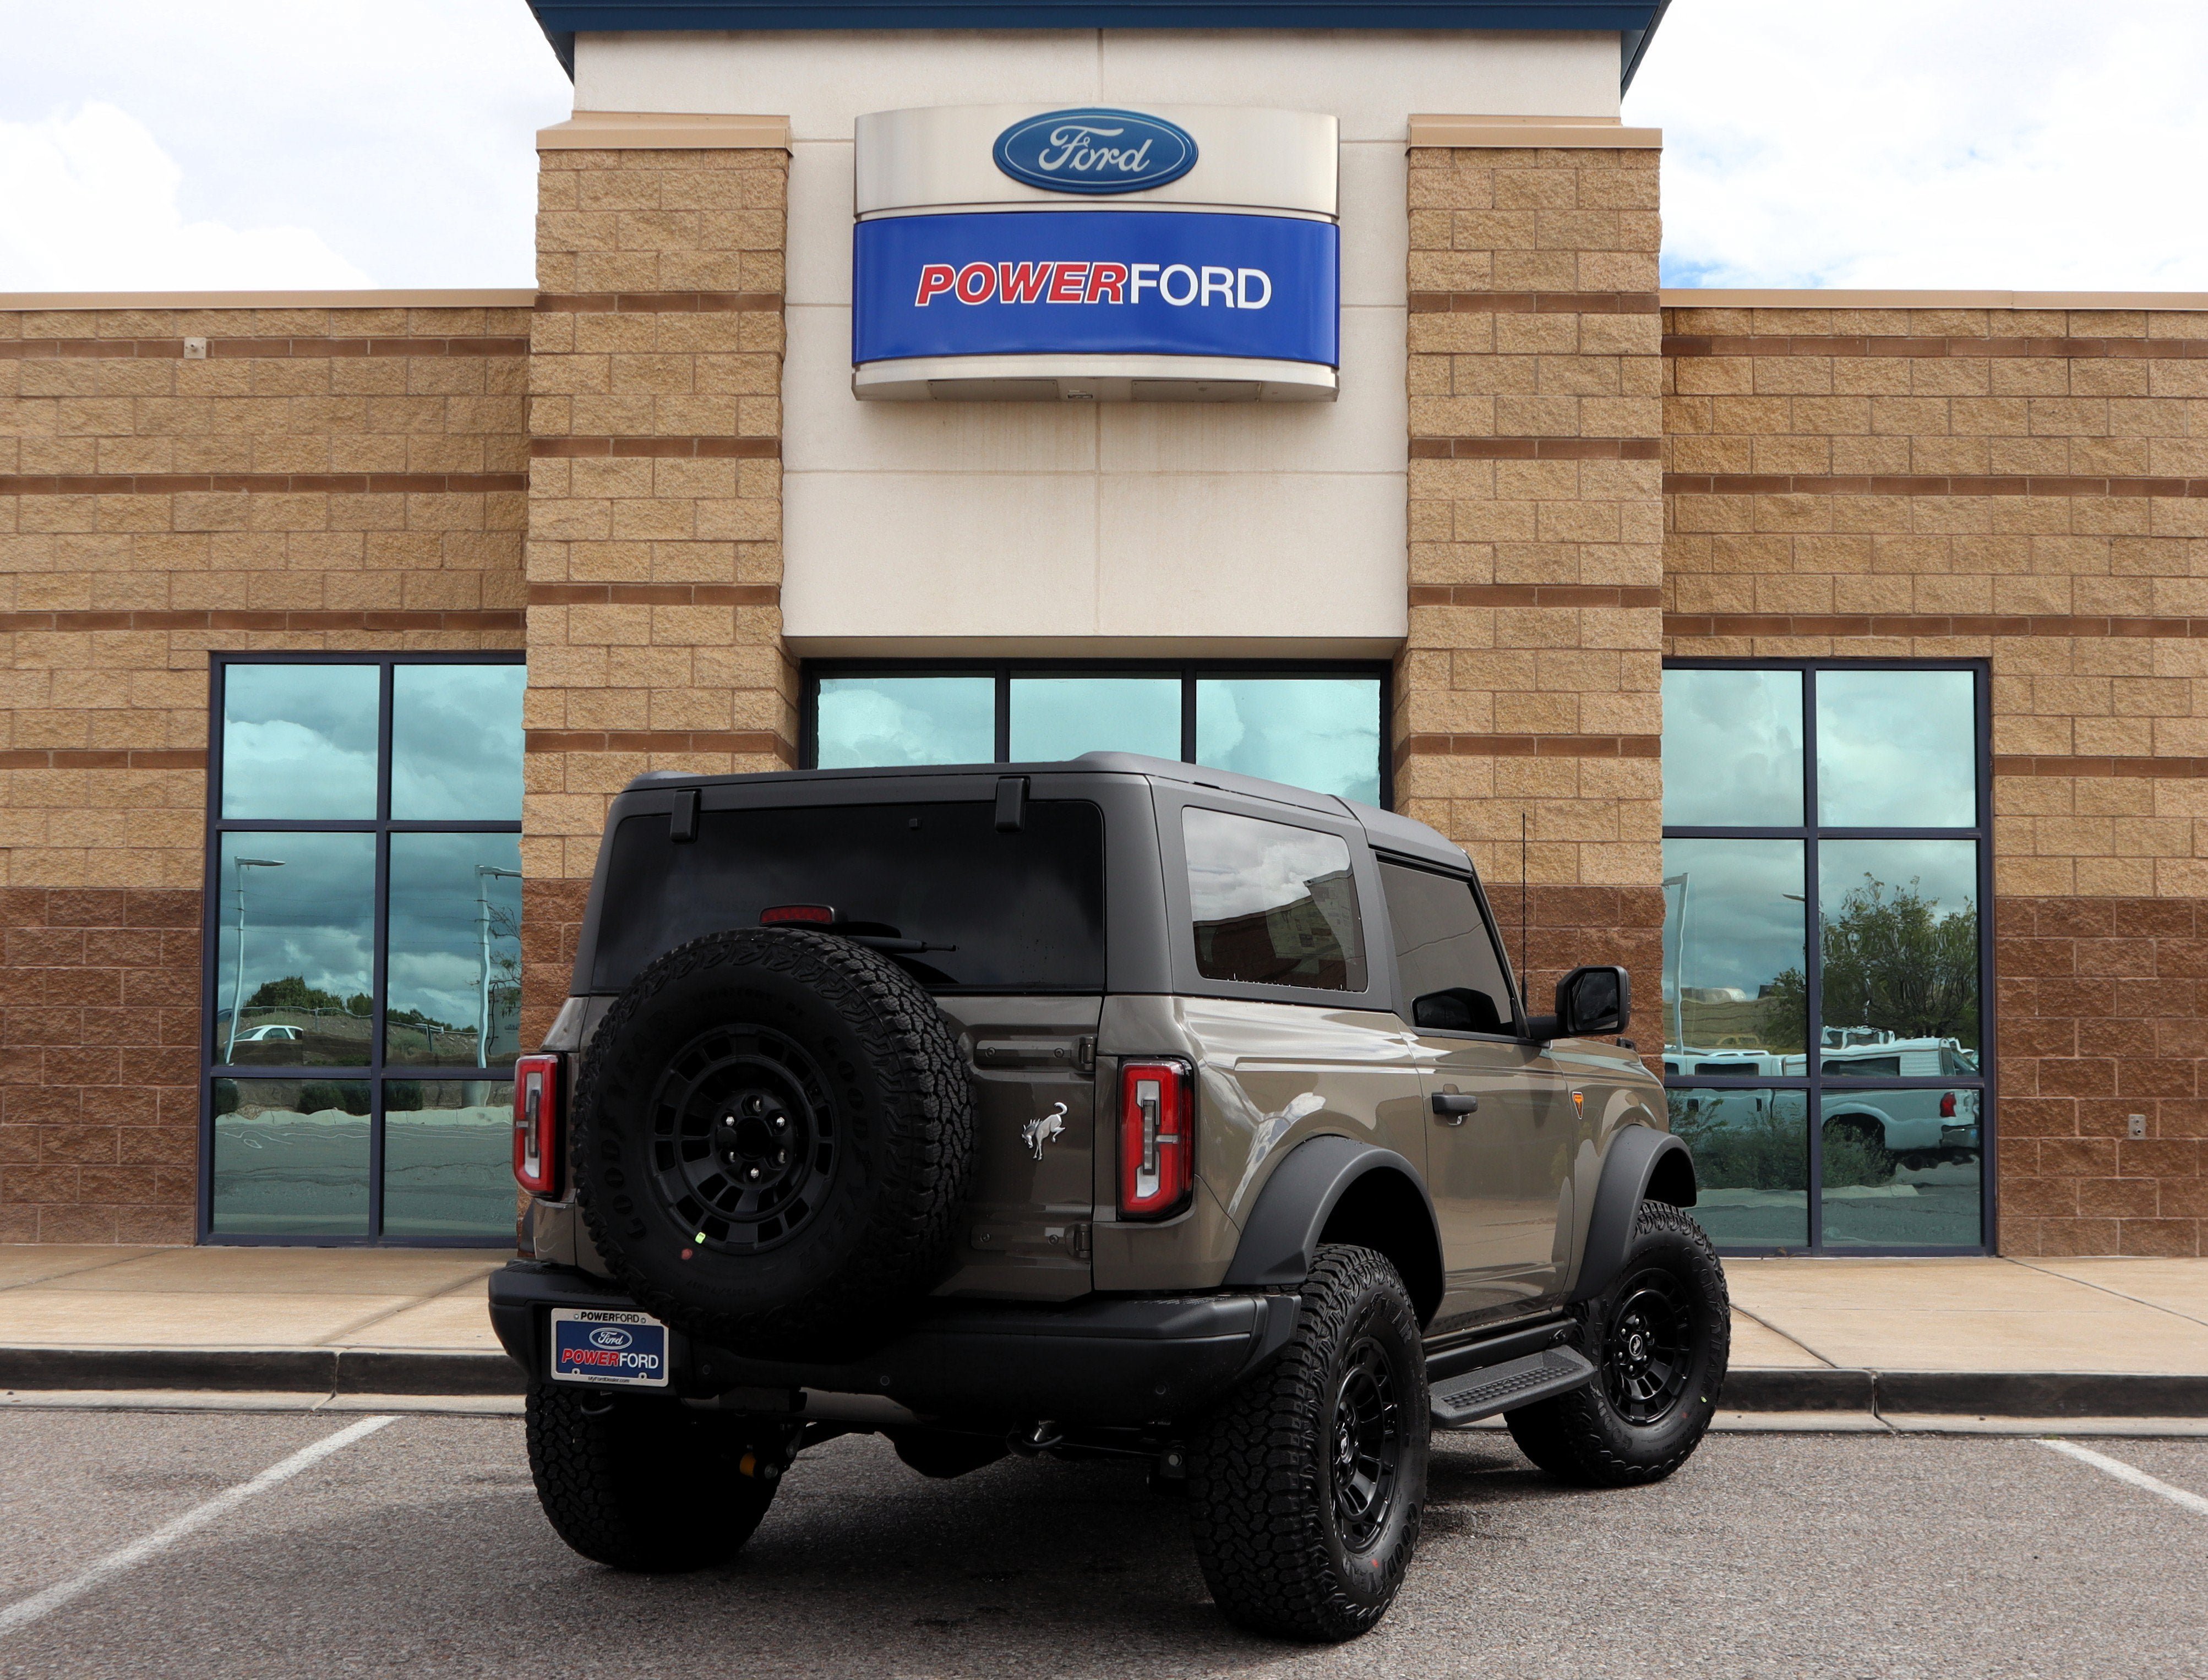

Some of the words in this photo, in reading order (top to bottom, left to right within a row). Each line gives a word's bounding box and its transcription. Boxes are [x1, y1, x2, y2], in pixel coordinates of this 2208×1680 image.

[1039, 124, 1154, 173] Ford
[914, 261, 1272, 309] POWERFORD
[580, 1312, 640, 1323] POWERFORD
[598, 1330, 623, 1345] Ford
[561, 1349, 659, 1369] POWERFORD
